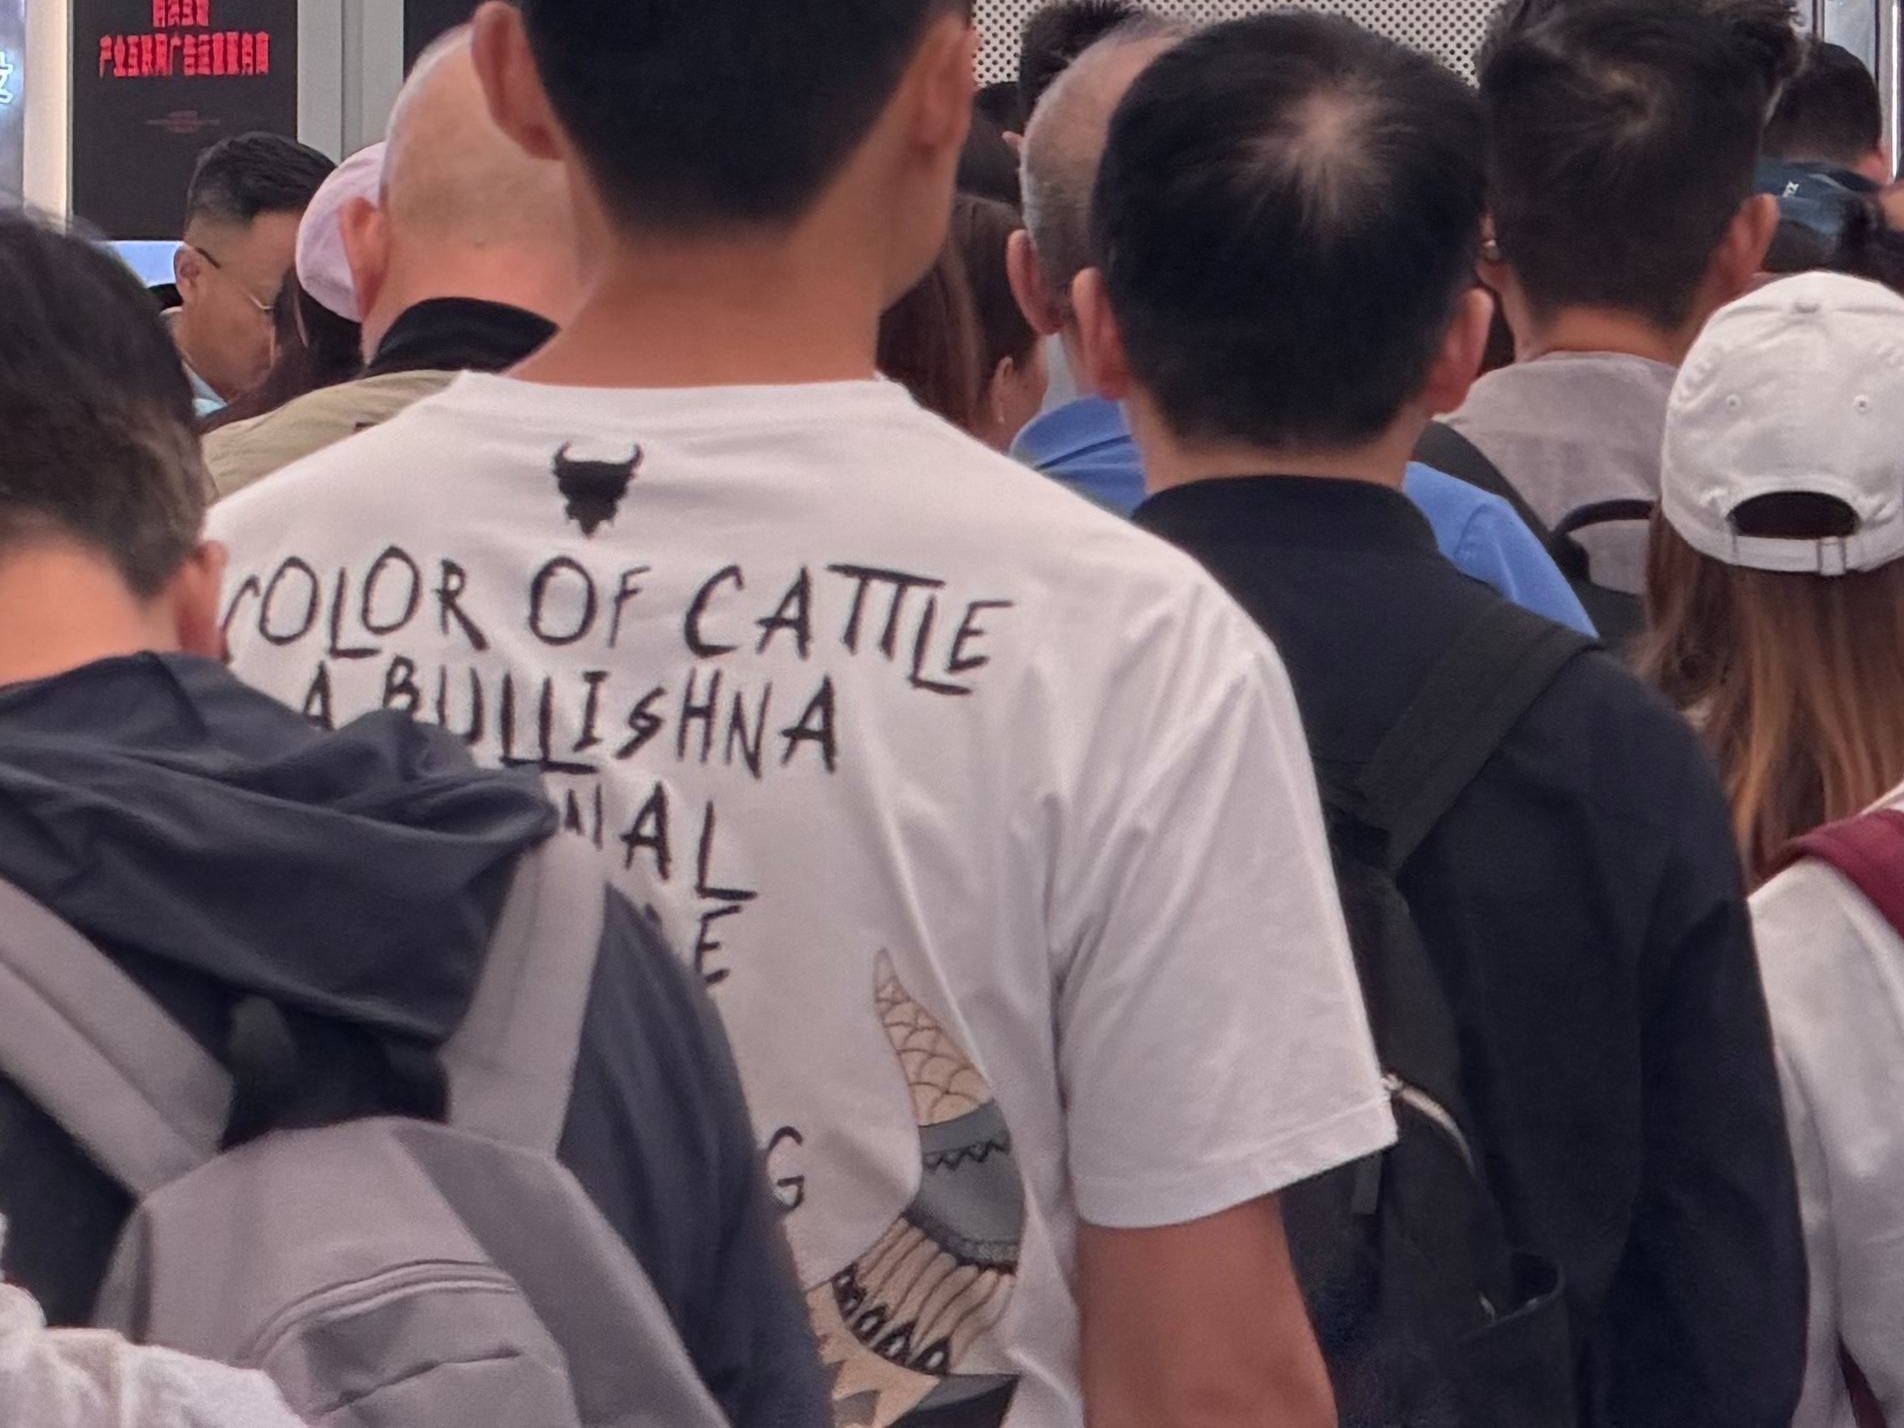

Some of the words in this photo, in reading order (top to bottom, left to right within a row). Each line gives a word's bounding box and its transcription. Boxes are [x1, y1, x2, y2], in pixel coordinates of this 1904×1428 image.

[222, 546, 490, 659] COLOR
[529, 555, 652, 649] OF
[684, 562, 1014, 697] CATTLE
